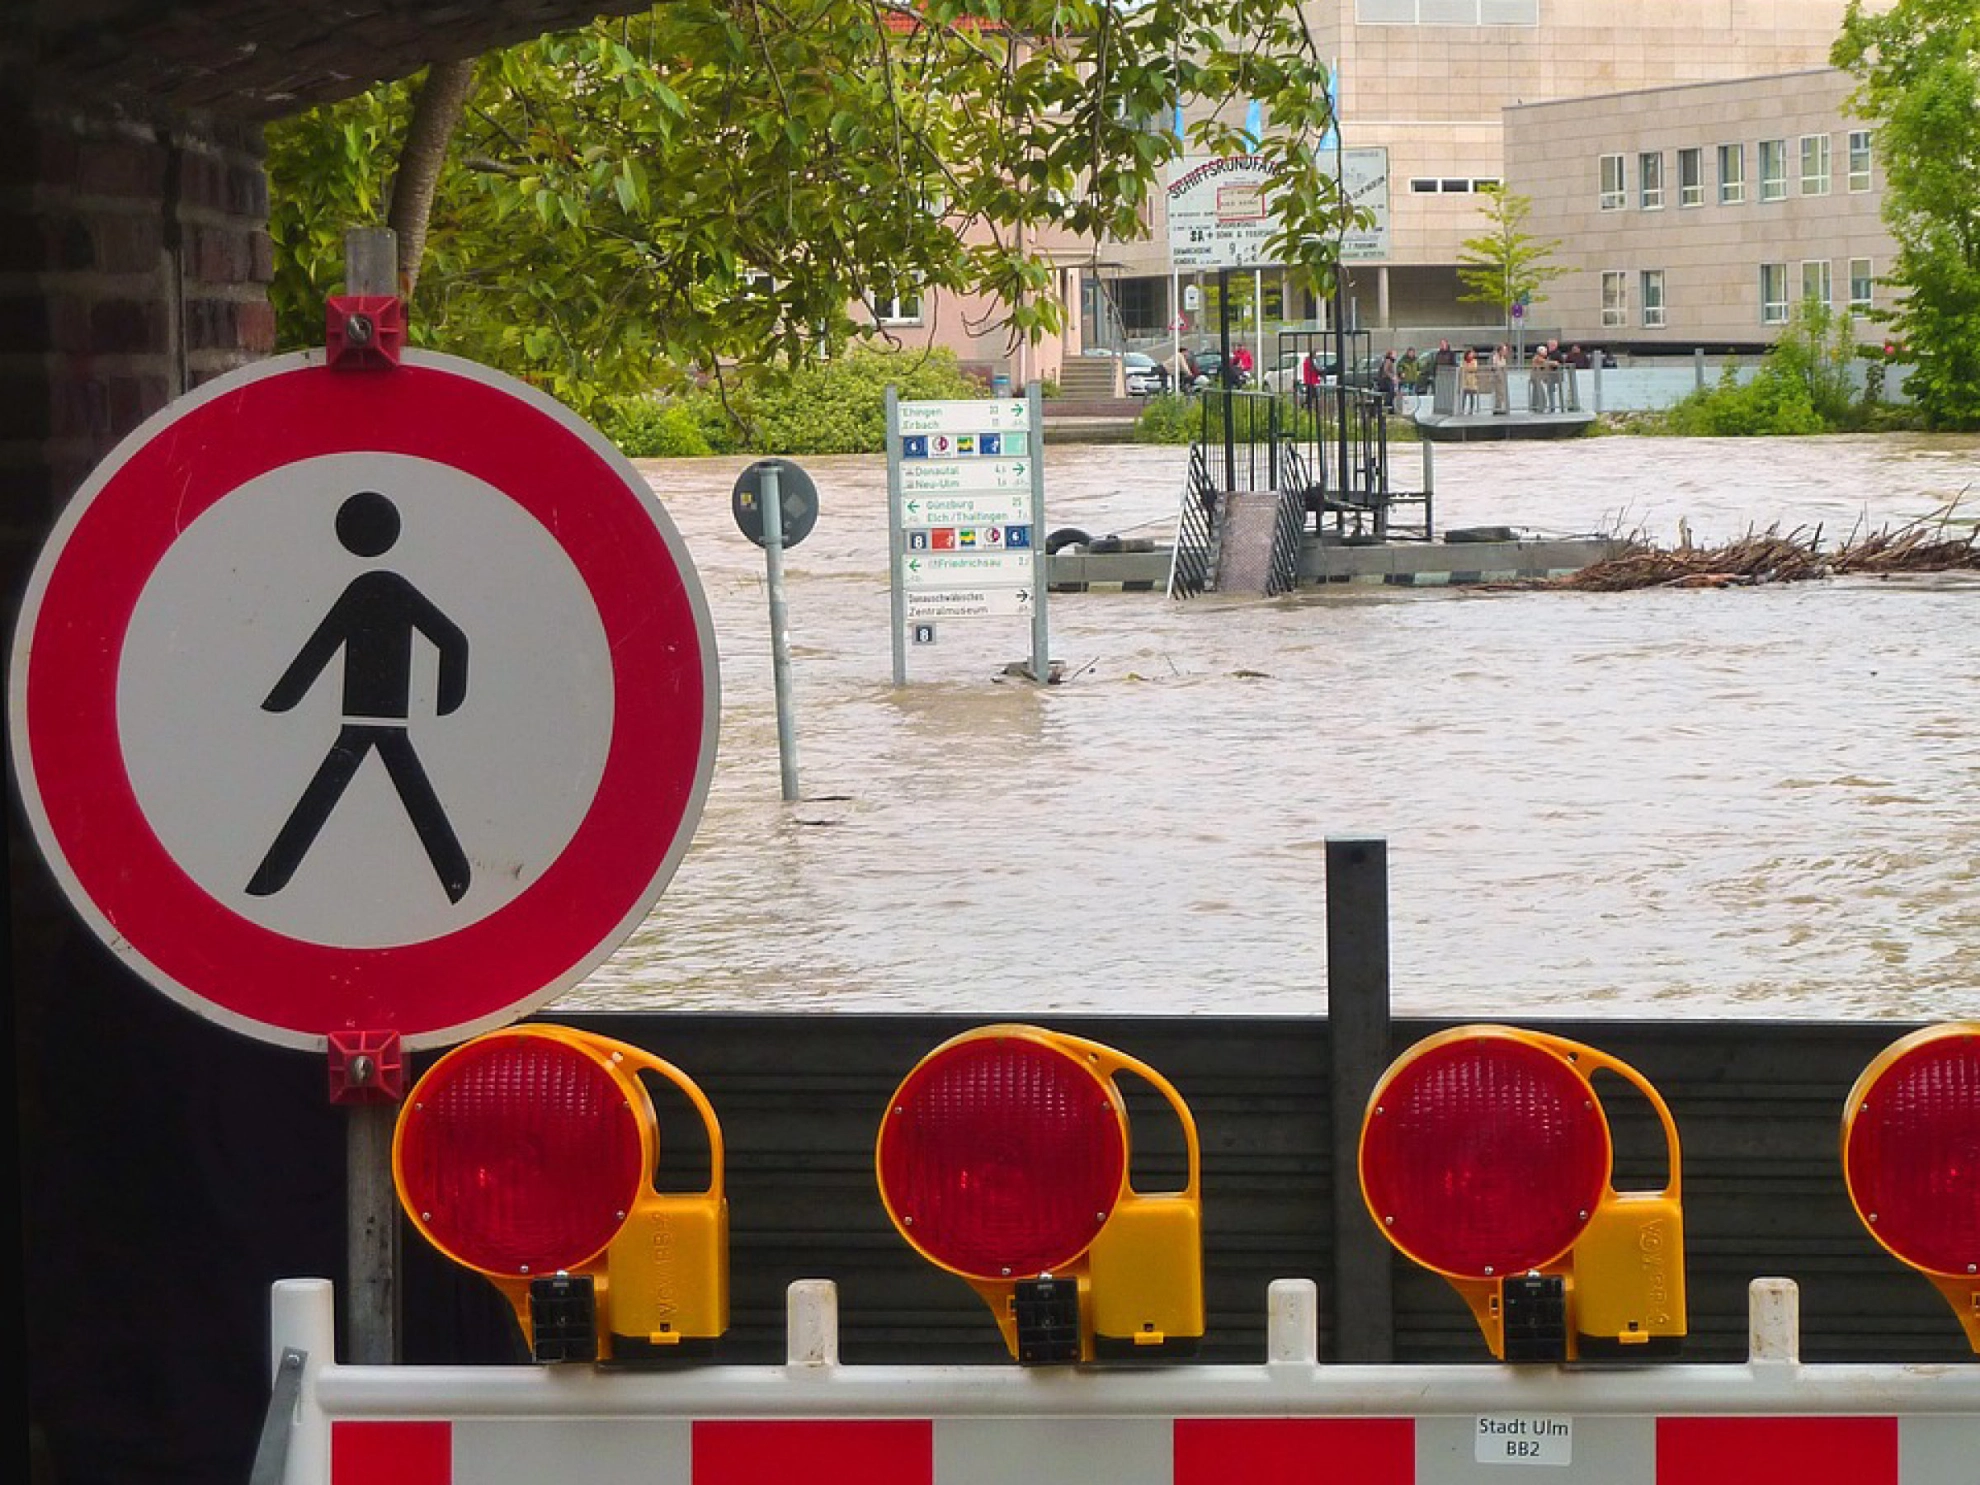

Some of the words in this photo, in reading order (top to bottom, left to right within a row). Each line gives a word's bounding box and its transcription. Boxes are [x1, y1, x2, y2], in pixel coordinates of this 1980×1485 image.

[902, 407, 943, 419] Ehingen
[902, 420, 939, 430] Erbach
[915, 466, 959, 476] Donautal
[915, 478, 960, 489] Neu-Ulm
[926, 500, 974, 511] Günzburg
[938, 559, 1001, 569] Friedrichsau
[908, 606, 988, 617] Zentralmuseum
[1479, 1418, 1527, 1434] Stadt
[1532, 1418, 1569, 1436] Ulm
[1507, 1441, 1540, 1457] BB2
